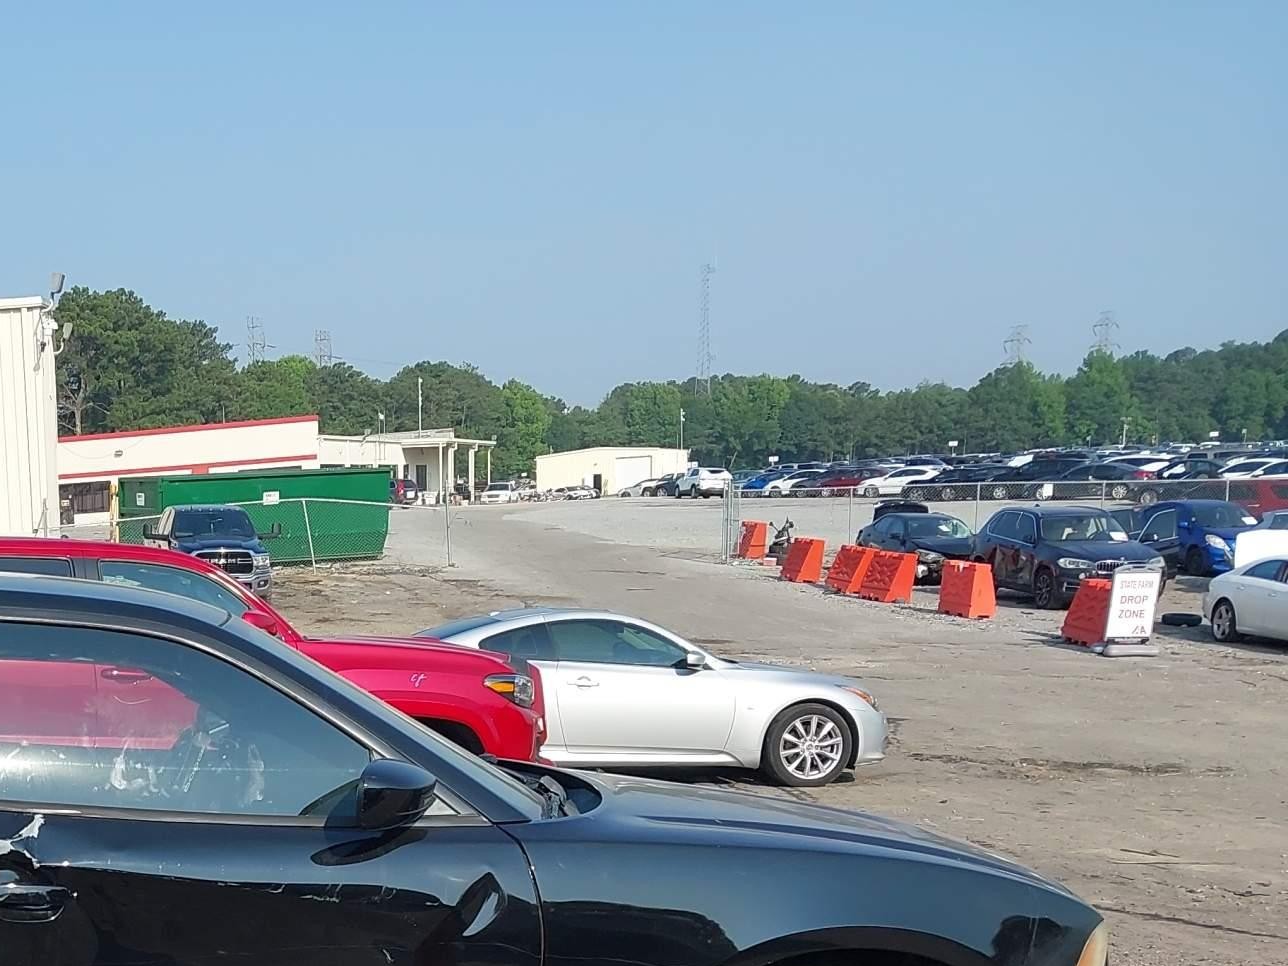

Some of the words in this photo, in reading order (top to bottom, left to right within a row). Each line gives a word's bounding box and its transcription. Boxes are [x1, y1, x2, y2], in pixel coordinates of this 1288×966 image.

[1120, 580, 1137, 589] STATE
[1120, 595, 1148, 605] DROP
[1118, 609, 1145, 619] ZONE
